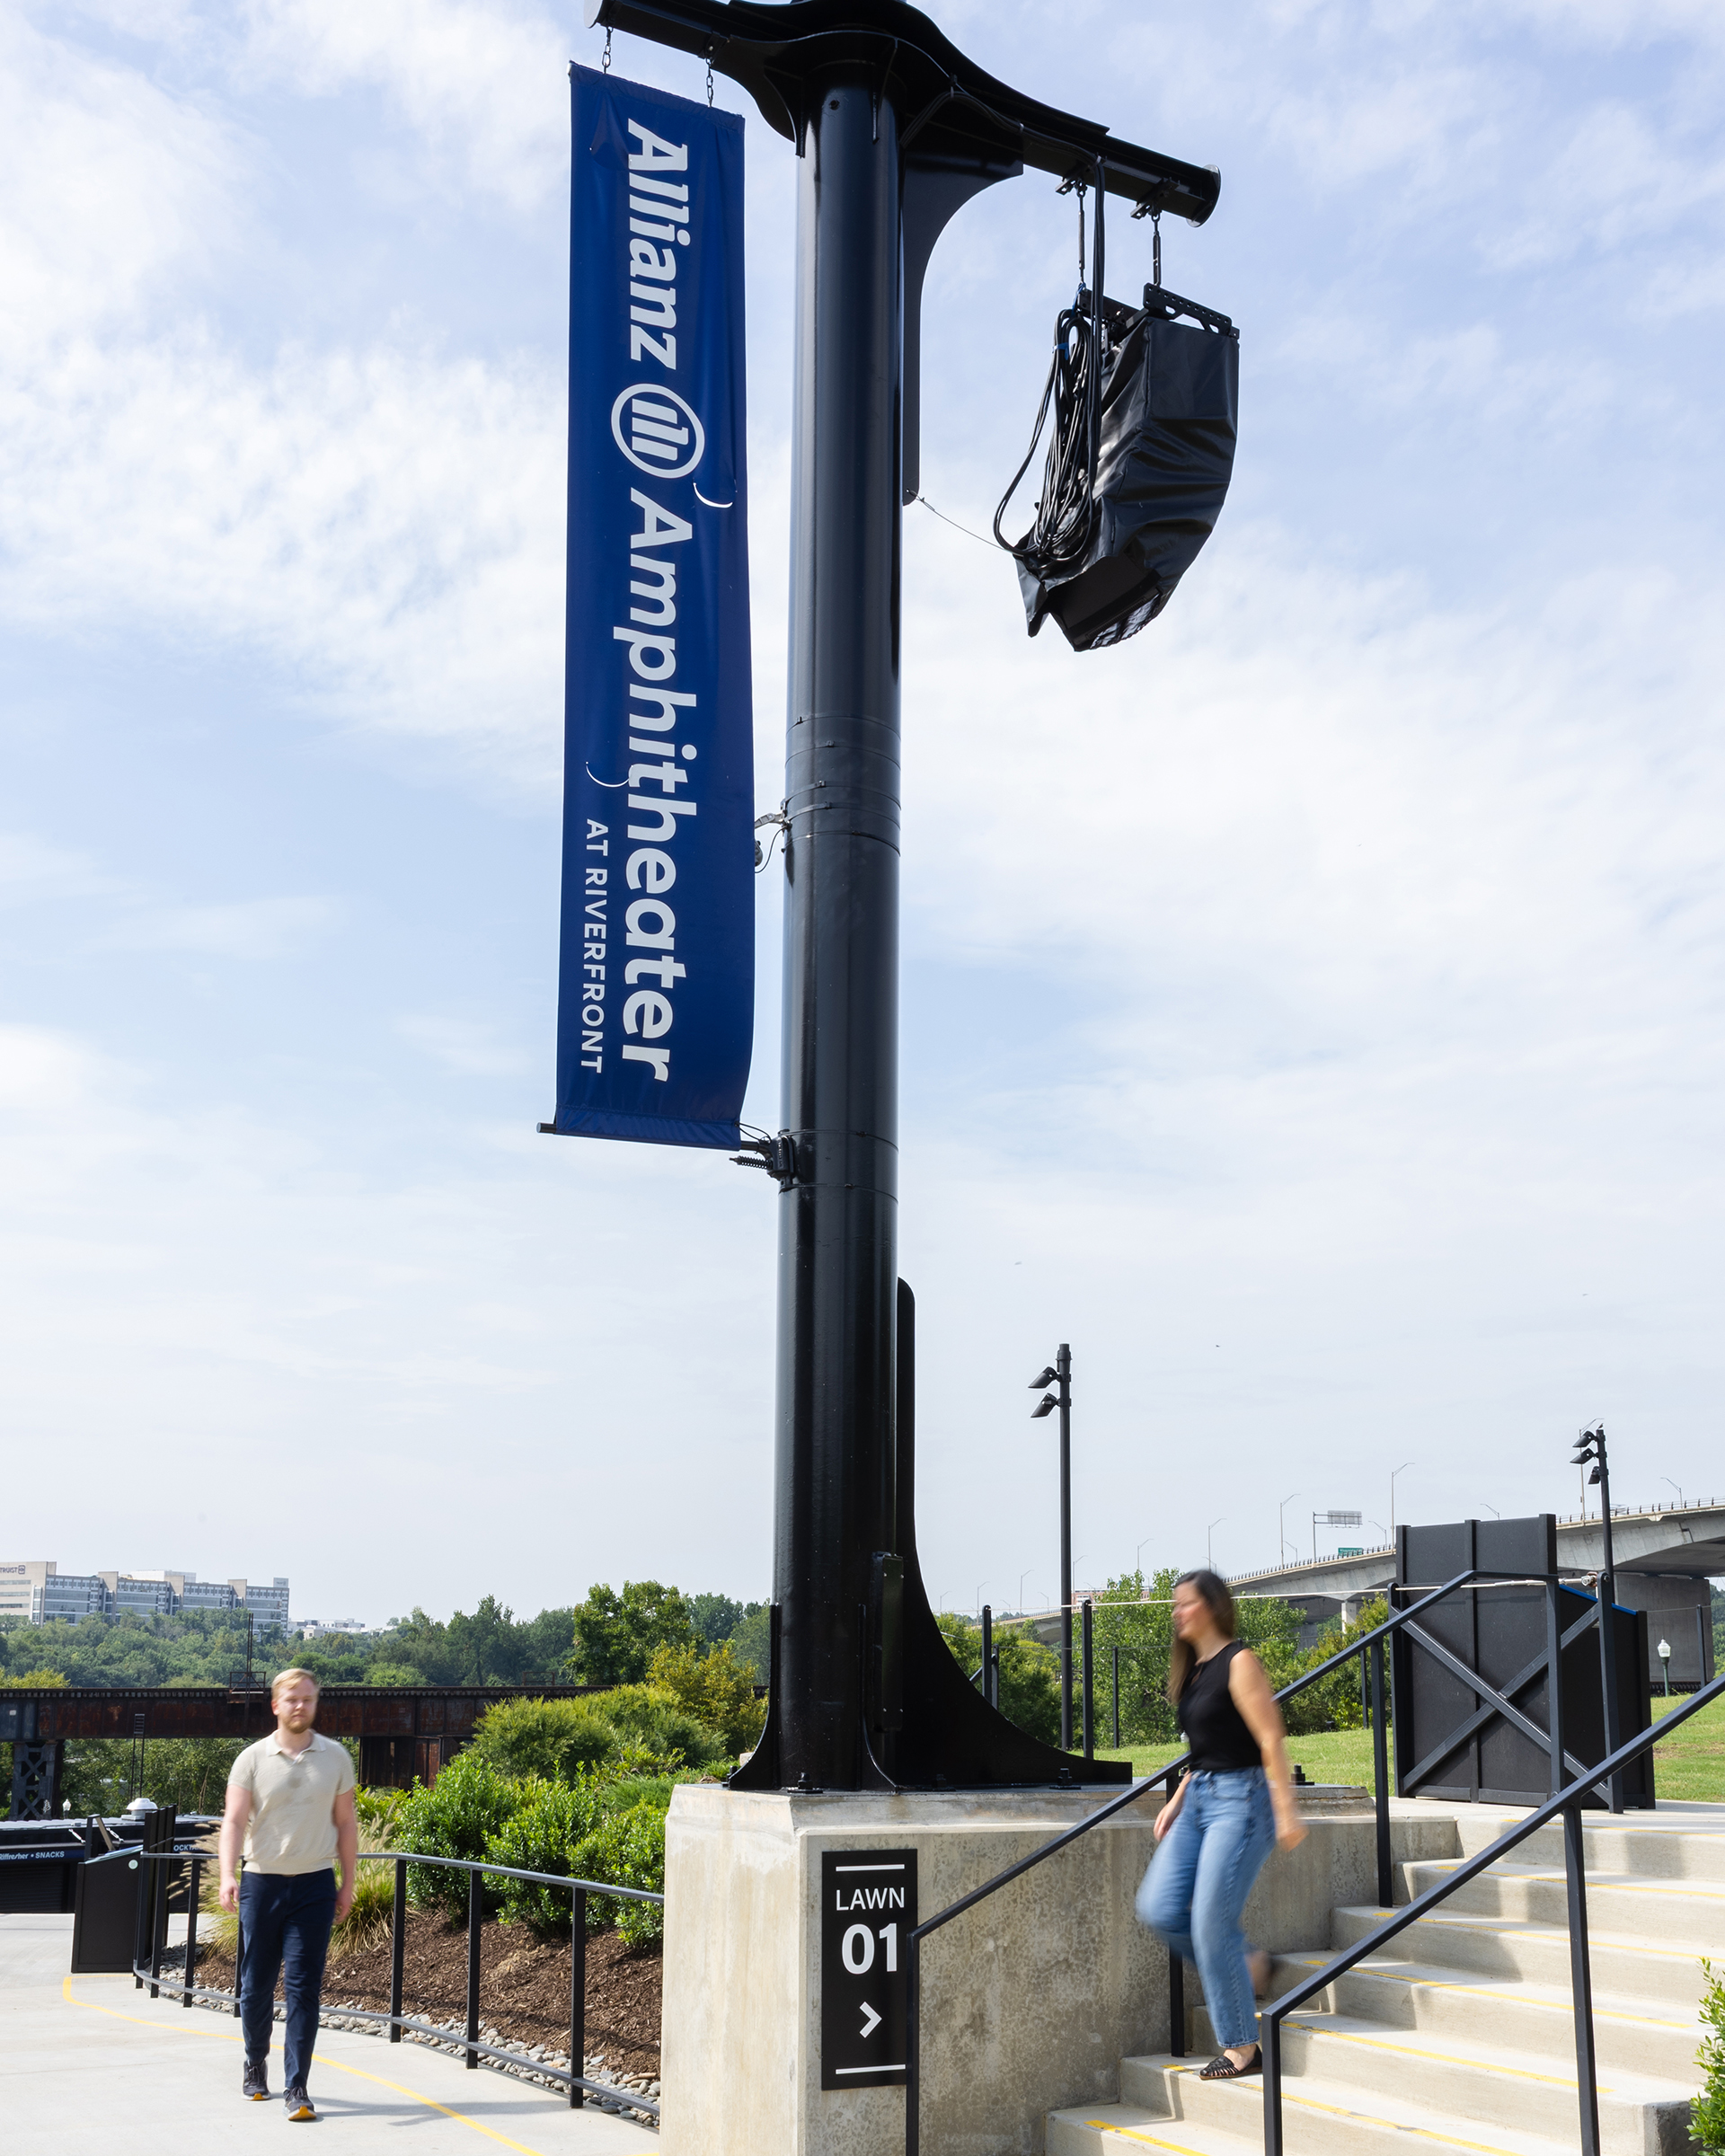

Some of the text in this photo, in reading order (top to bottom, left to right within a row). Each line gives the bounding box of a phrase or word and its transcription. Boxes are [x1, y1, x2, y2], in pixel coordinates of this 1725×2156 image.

[614, 119, 697, 1082] Allianz Amphitheater
[580, 819, 609, 1074] AT RIVERFRONT
[35, 1851, 65, 1860] SNACKS
[836, 1887, 905, 1911] LAWN
[841, 1922, 898, 1975] 01
